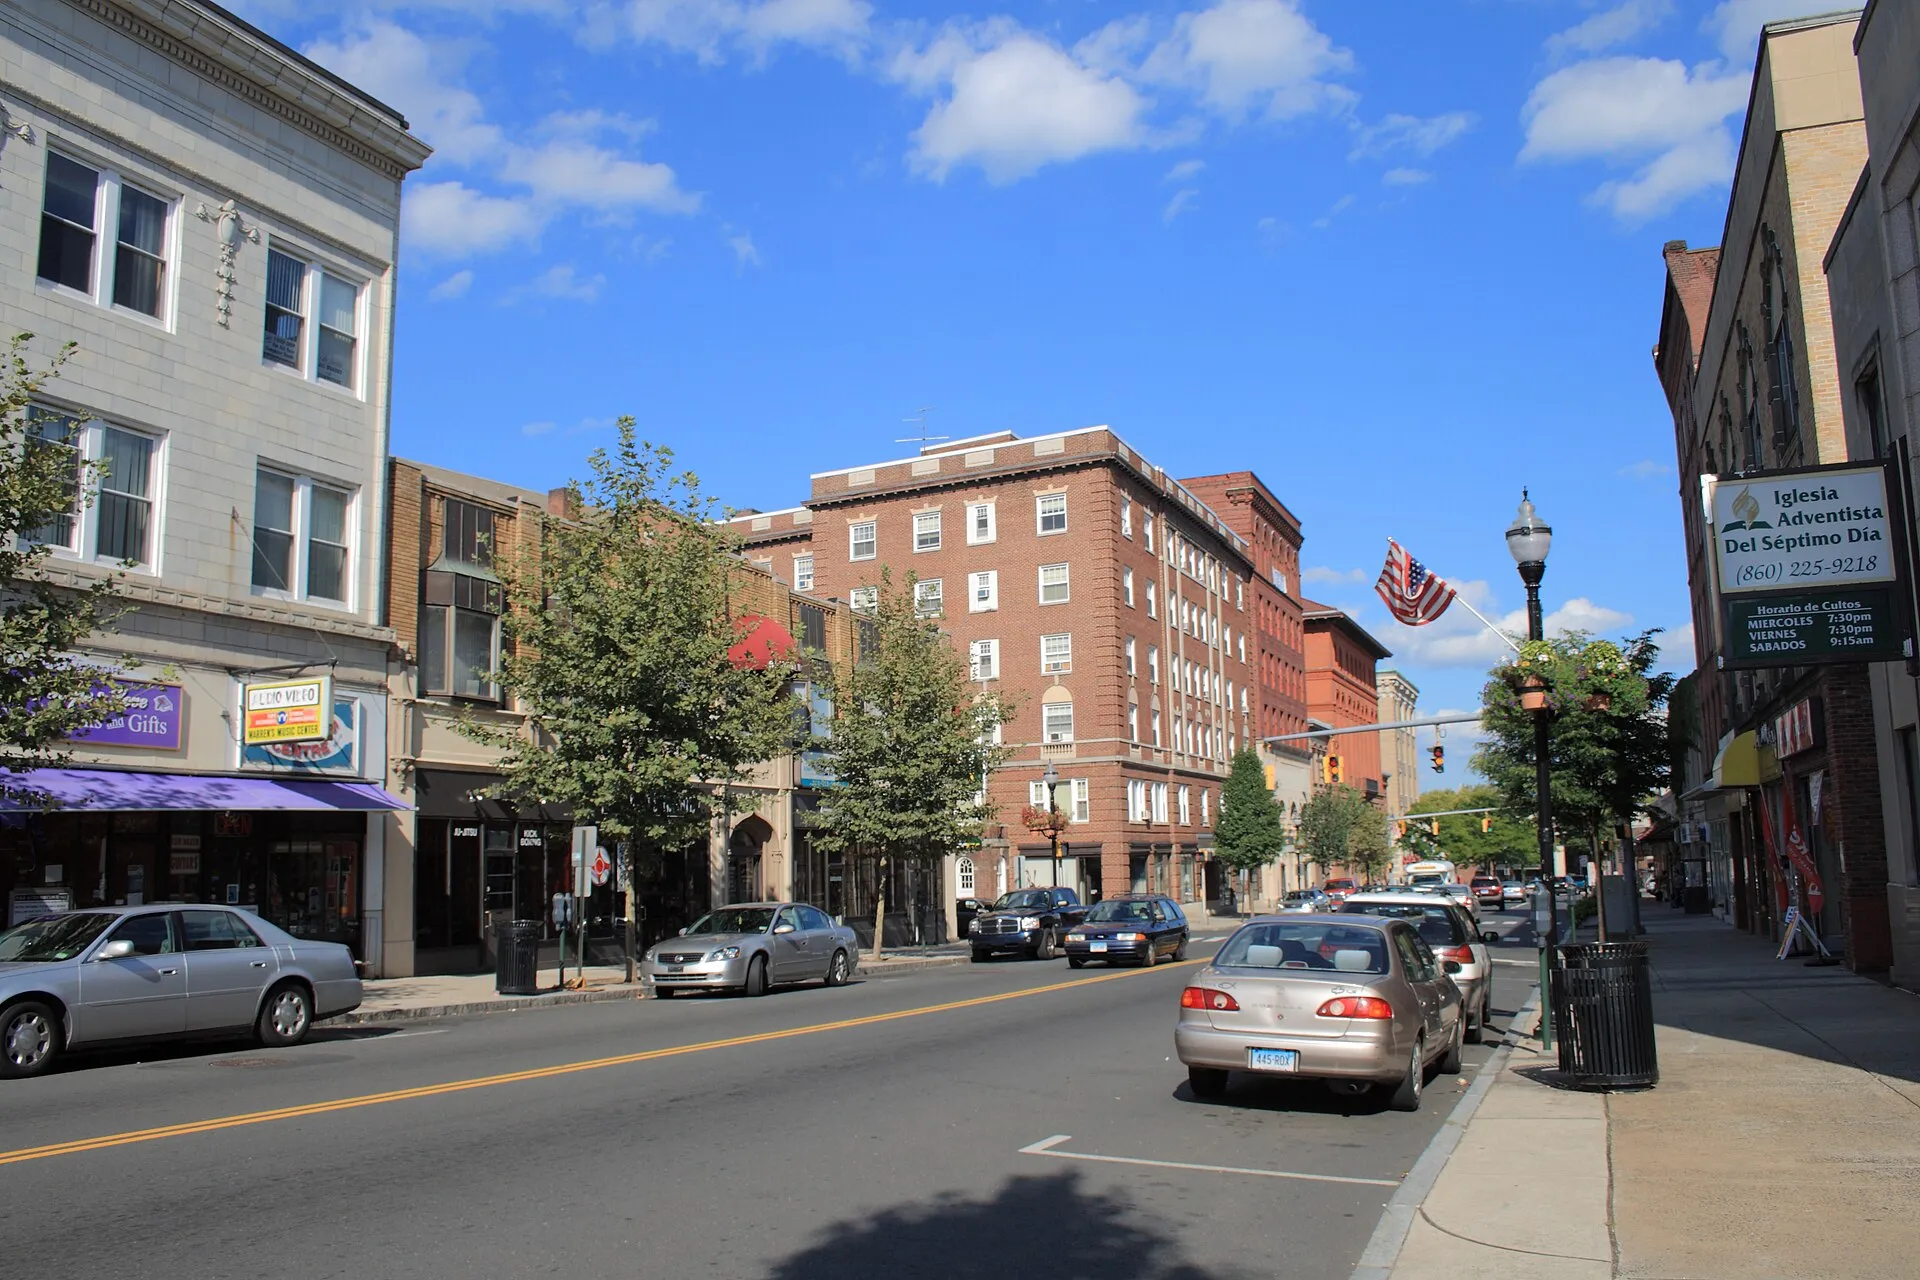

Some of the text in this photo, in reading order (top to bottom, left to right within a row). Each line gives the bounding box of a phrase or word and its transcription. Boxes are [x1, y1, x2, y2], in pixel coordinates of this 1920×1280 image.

[1774, 486, 1839, 508] Iglesia
[1777, 505, 1884, 527] Adventista
[1725, 527, 1882, 554] Del Séptimo Día
[1736, 555, 1878, 585] (860) 225-9218
[1757, 600, 1861, 615] Horario de Cultos
[1747, 613, 1872, 629] MIERCOLES 7:30pm
[1749, 625, 1873, 641] VIERNES 7:30pm
[1750, 636, 1874, 652] SABADOS 9:15am
[106, 716, 124, 730] and
[128, 713, 167, 735] Gifts
[248, 728, 275, 739] WARREN'S
[277, 726, 295, 737] MUSIC
[296, 724, 318, 735] CENTER
[523, 829, 538, 838] KICK
